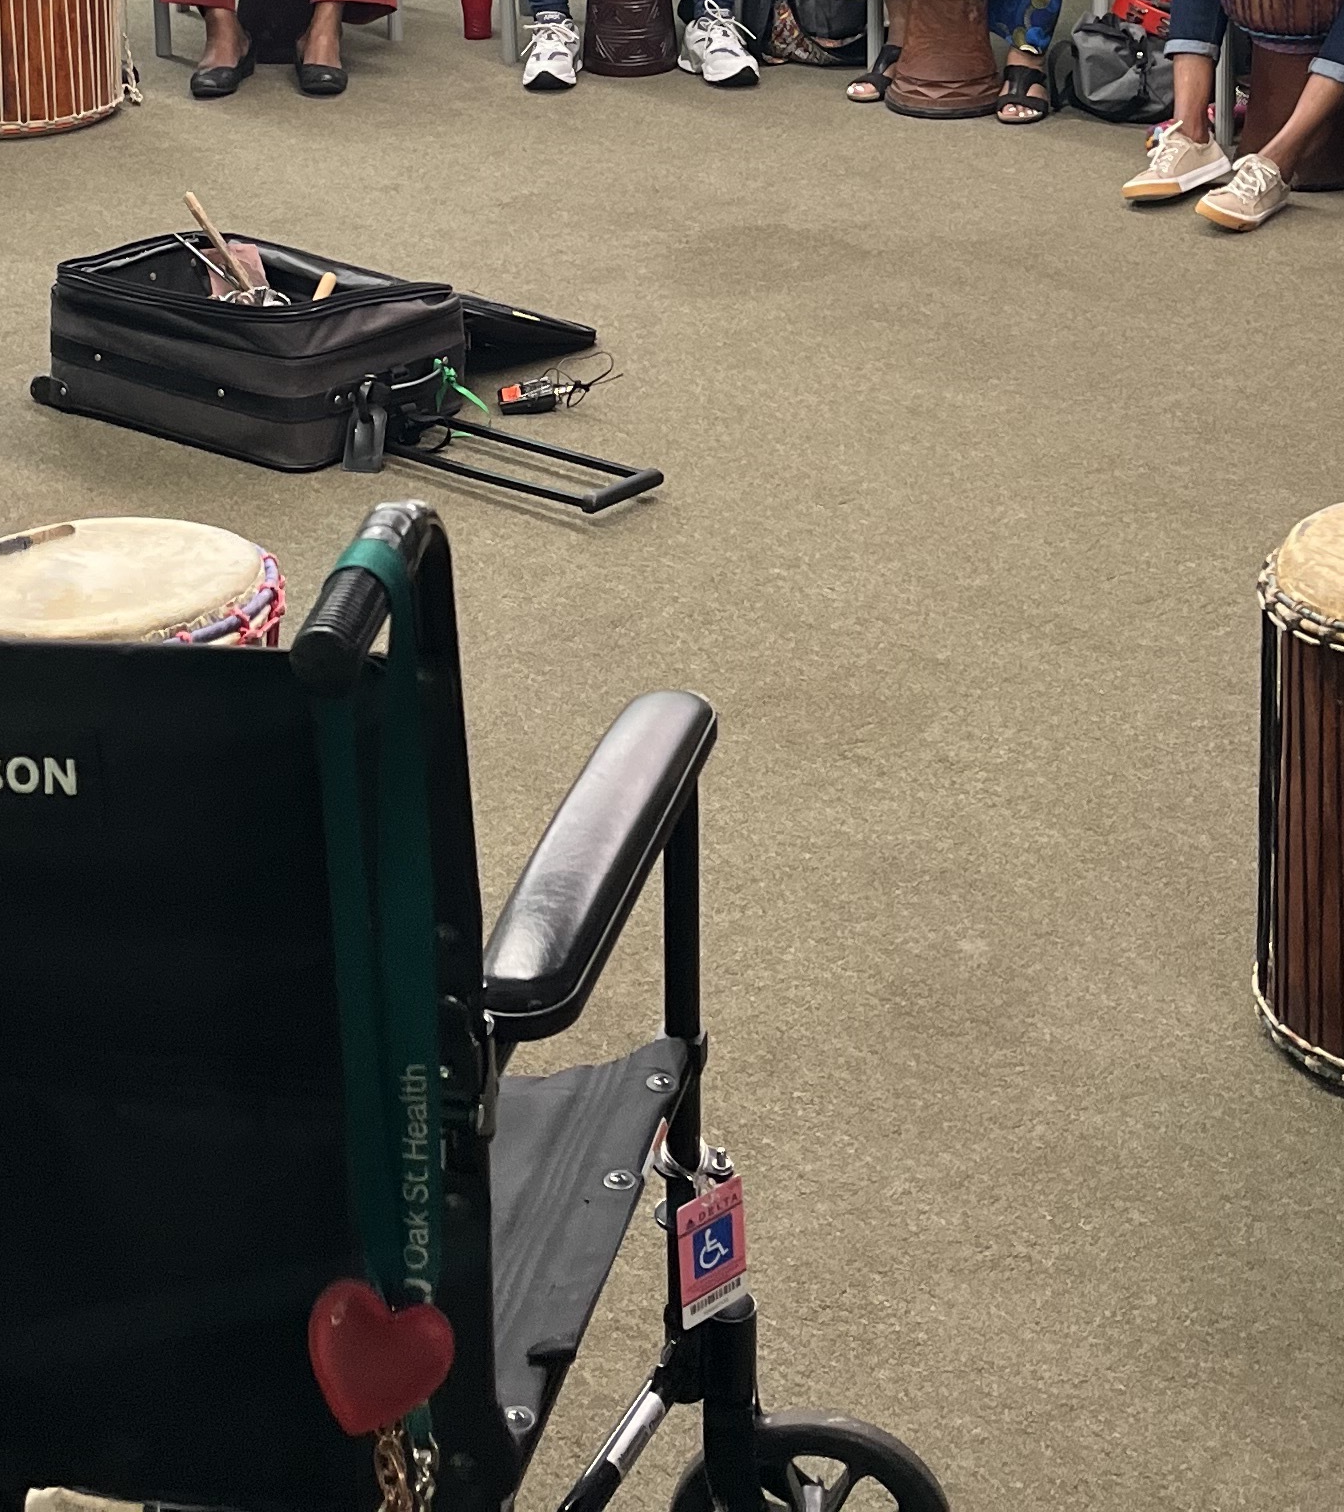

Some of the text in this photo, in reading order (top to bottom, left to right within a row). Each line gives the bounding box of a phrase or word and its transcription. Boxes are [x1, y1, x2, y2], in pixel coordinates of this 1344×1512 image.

[398, 1063, 429, 1270] Oak St Health
[697, 1192, 738, 1222] DELTA
